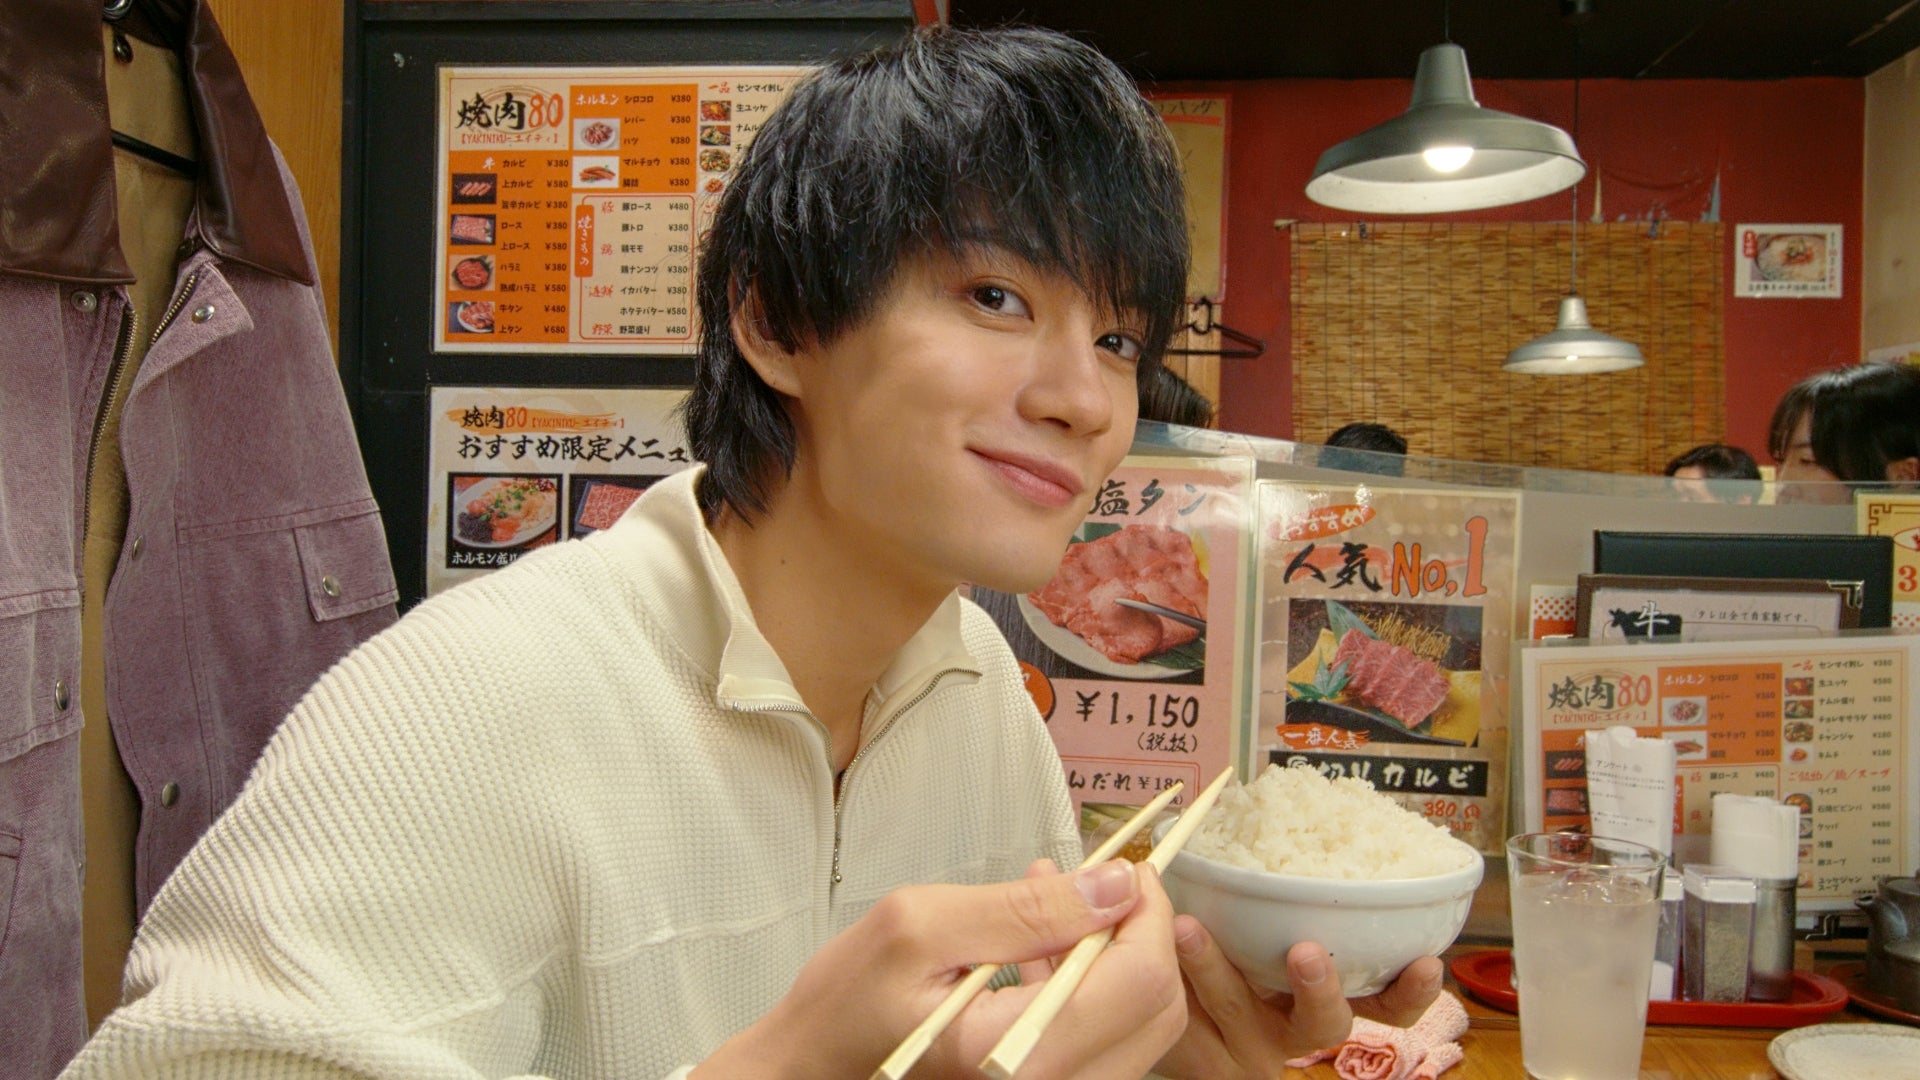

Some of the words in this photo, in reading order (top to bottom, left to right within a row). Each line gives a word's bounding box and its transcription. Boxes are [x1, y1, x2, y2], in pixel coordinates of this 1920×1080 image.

[708, 81, 730, 94] 一品
[736, 83, 784, 93] センマイ刺し
[576, 94, 619, 106] ホルモン
[624, 95, 654, 104] シロコロ
[671, 95, 691, 103] ¥380
[455, 92, 563, 130] 焼肉80
[736, 104, 768, 113] 生ユッケ
[624, 137, 639, 145] ハツ
[502, 159, 526, 168] カルビ
[547, 159, 569, 168] ¥380
[623, 158, 660, 166] マルチョウ
[502, 180, 534, 189] 上カルビ
[669, 178, 689, 186] ¥380
[546, 201, 568, 209] ¥380
[622, 202, 652, 211] 豚ロース
[669, 202, 689, 210] ¥480
[501, 222, 522, 230] ロース
[546, 222, 568, 230] ¥380
[622, 224, 644, 232] 豚トロ
[501, 243, 530, 251] 上ロース
[545, 242, 568, 250] ¥580
[621, 244, 644, 253] 鶏モモ
[668, 245, 688, 253] ¥380
[500, 264, 521, 272] ハラミ
[545, 263, 567, 271] ¥380
[621, 265, 658, 274] 鶏ナンコツ
[667, 266, 688, 274] ¥380
[544, 284, 566, 292] ¥580
[620, 287, 657, 295] イカバター
[500, 305, 523, 313] 牛タン
[544, 305, 566, 313] ¥480
[620, 307, 664, 316] ホタテバター
[667, 307, 687, 315] ¥580
[500, 325, 522, 334] 上タン
[544, 326, 566, 334] ¥680
[620, 325, 650, 335] 野菜盛り
[666, 326, 686, 334] ¥480
[462, 405, 527, 429] 焼肉80
[1634, 600, 1670, 638] 牛
[1792, 660, 1813, 670] 一品
[1664, 674, 1705, 685] ホルモン
[1075, 690, 1199, 728] ¥1,150
[1137, 732, 1197, 753] (税抜)
[1284, 728, 1361, 749] 一番人気
